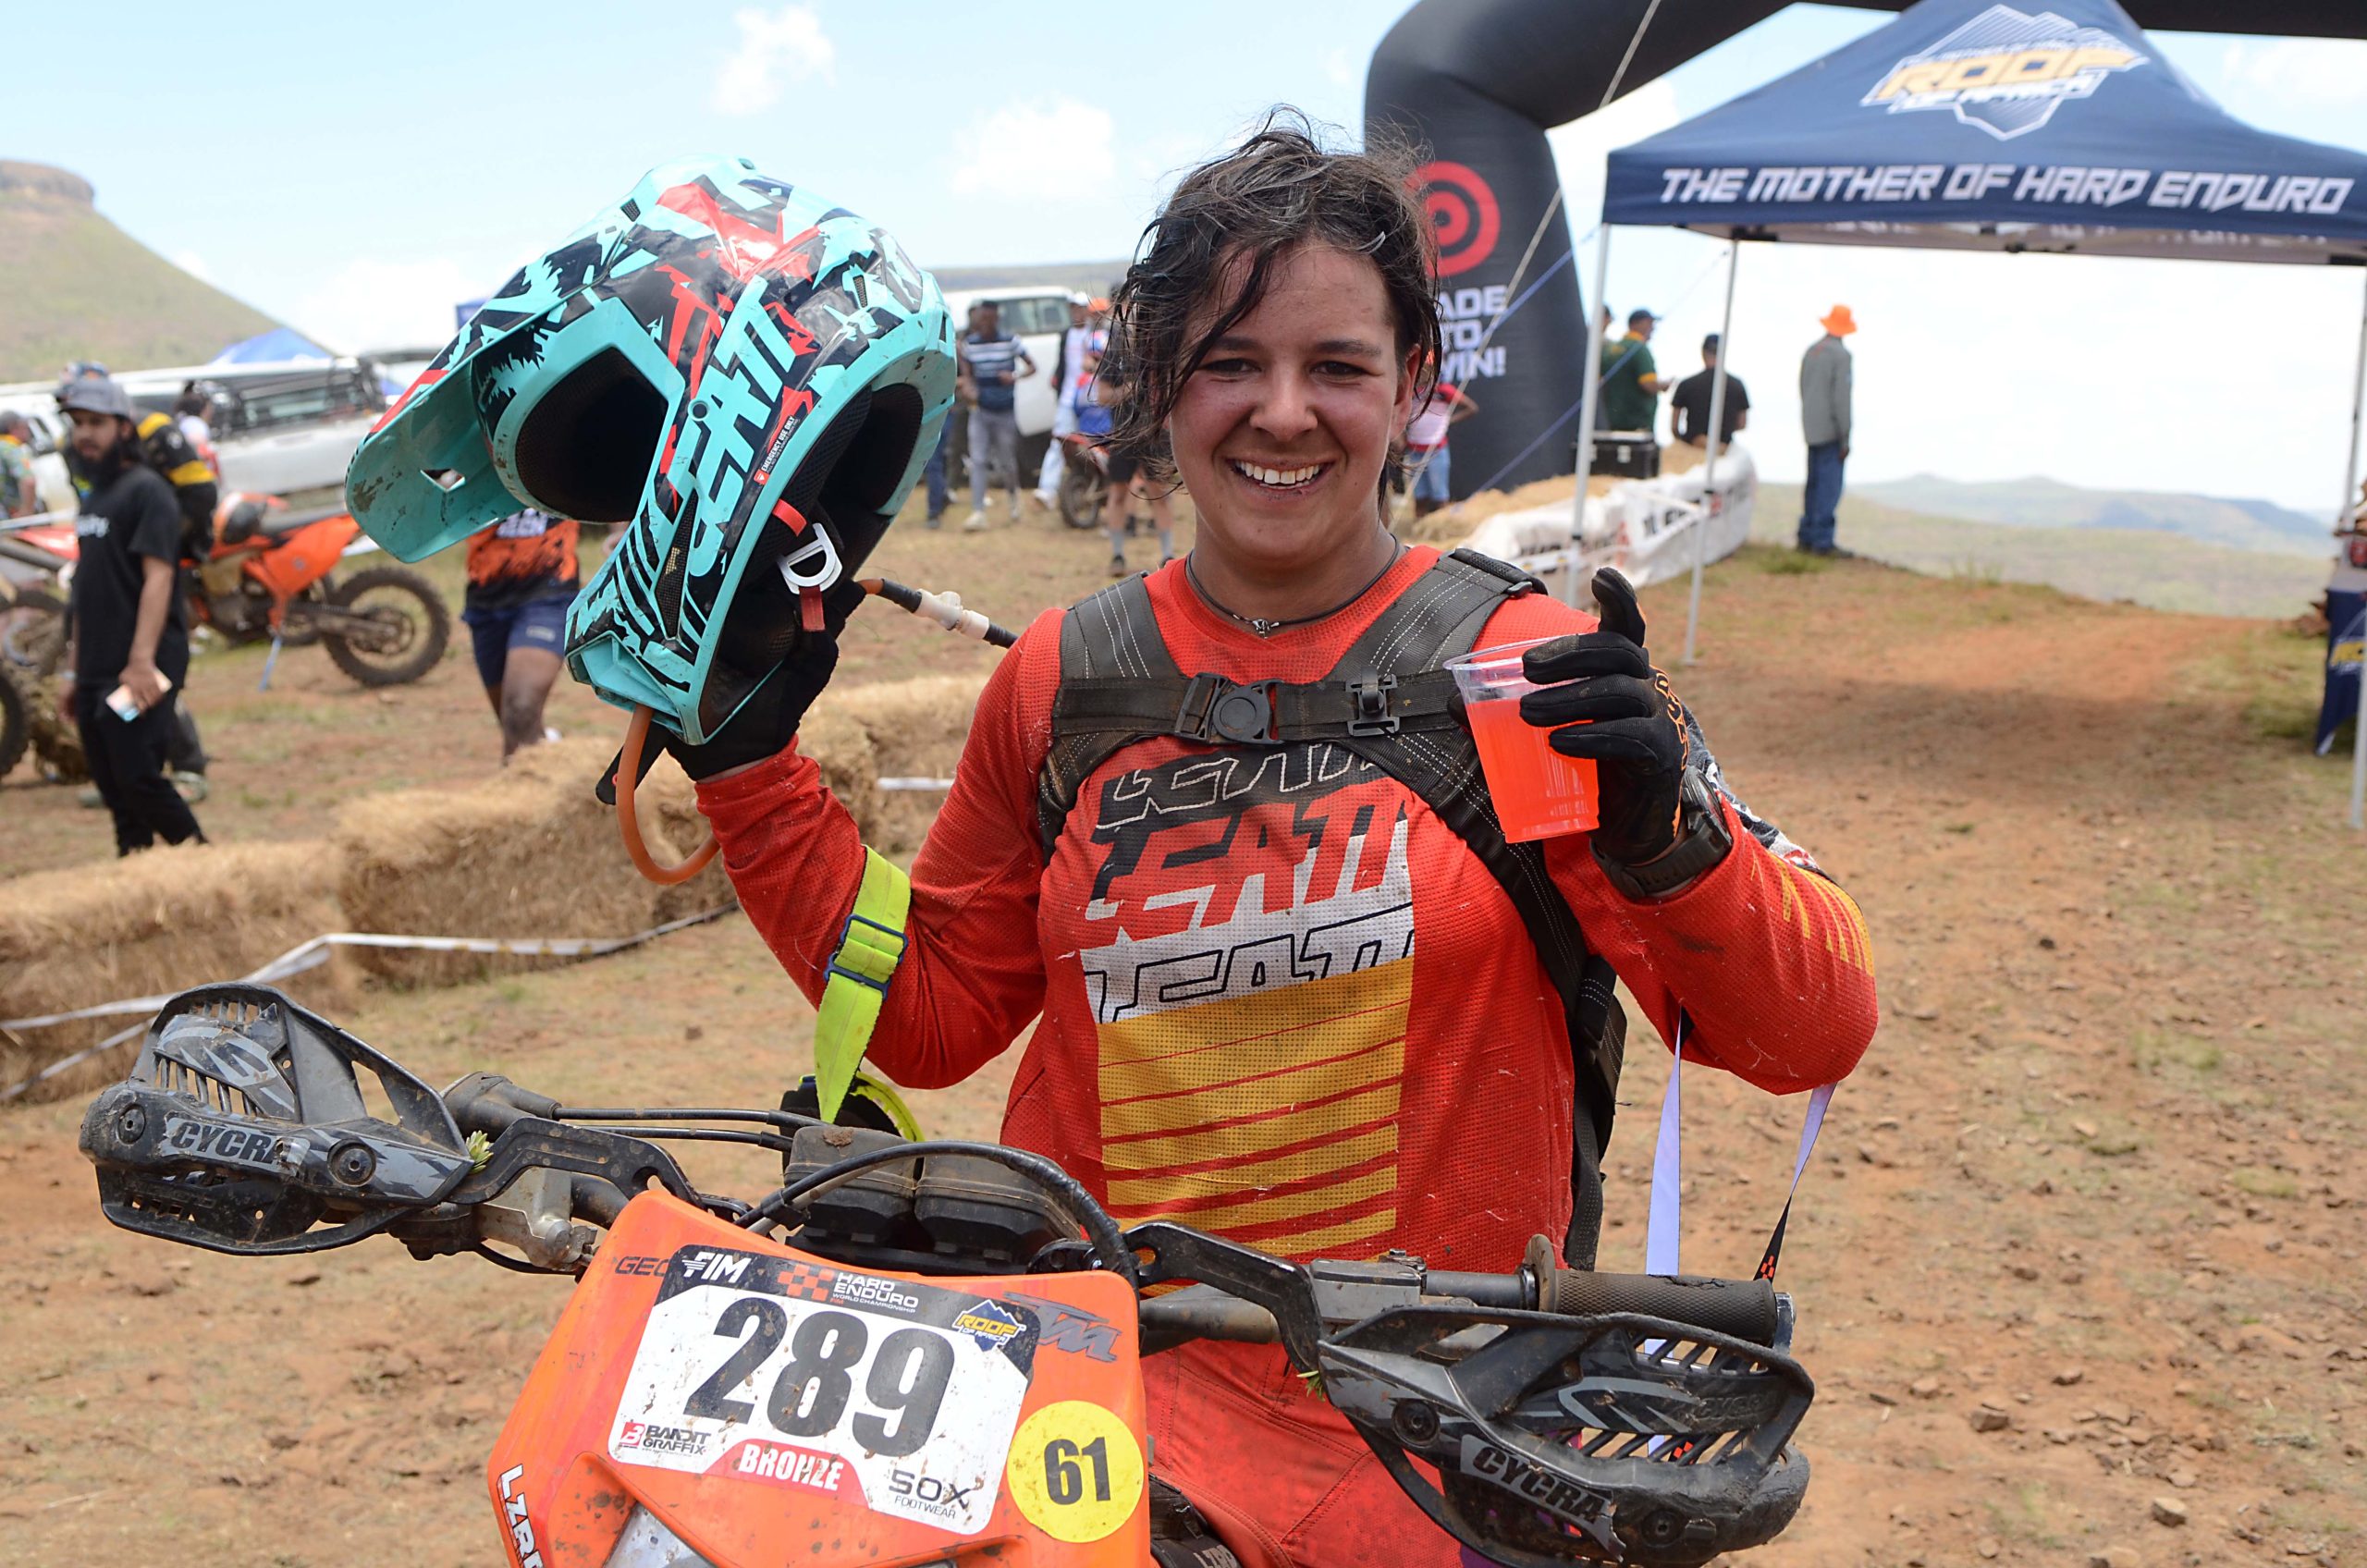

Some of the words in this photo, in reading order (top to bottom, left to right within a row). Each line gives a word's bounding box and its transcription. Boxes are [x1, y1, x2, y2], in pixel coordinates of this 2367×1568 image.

[1660, 167, 1748, 202] THE
[1747, 165, 1944, 202] MOTHER
[1943, 164, 2015, 201] OF
[2013, 166, 2151, 208] HARD
[2147, 170, 2355, 214] ENDURO
[1436, 284, 1507, 320] ADE
[760, 439, 782, 472] EMERGENCY
[778, 428, 789, 441] USE
[784, 415, 795, 431] ONLY
[681, 1251, 752, 1284] FIM
[837, 1271, 896, 1292] HARD
[832, 1292, 859, 1303] WORLD
[859, 1297, 916, 1313] CHAMPIONSHIP
[833, 1282, 919, 1308] ENDURO
[956, 1313, 1019, 1336] ROOF
[682, 1296, 955, 1458] 289
[643, 1438, 705, 1455] GRAFFIX
[646, 1425, 712, 1445] BANDIT
[738, 1443, 844, 1491] BRONZE
[1043, 1436, 1110, 1506] 61
[889, 1469, 972, 1510] SOX
[1472, 1446, 1606, 1525] CYCRA
[894, 1495, 957, 1520] FOOTWEAR
